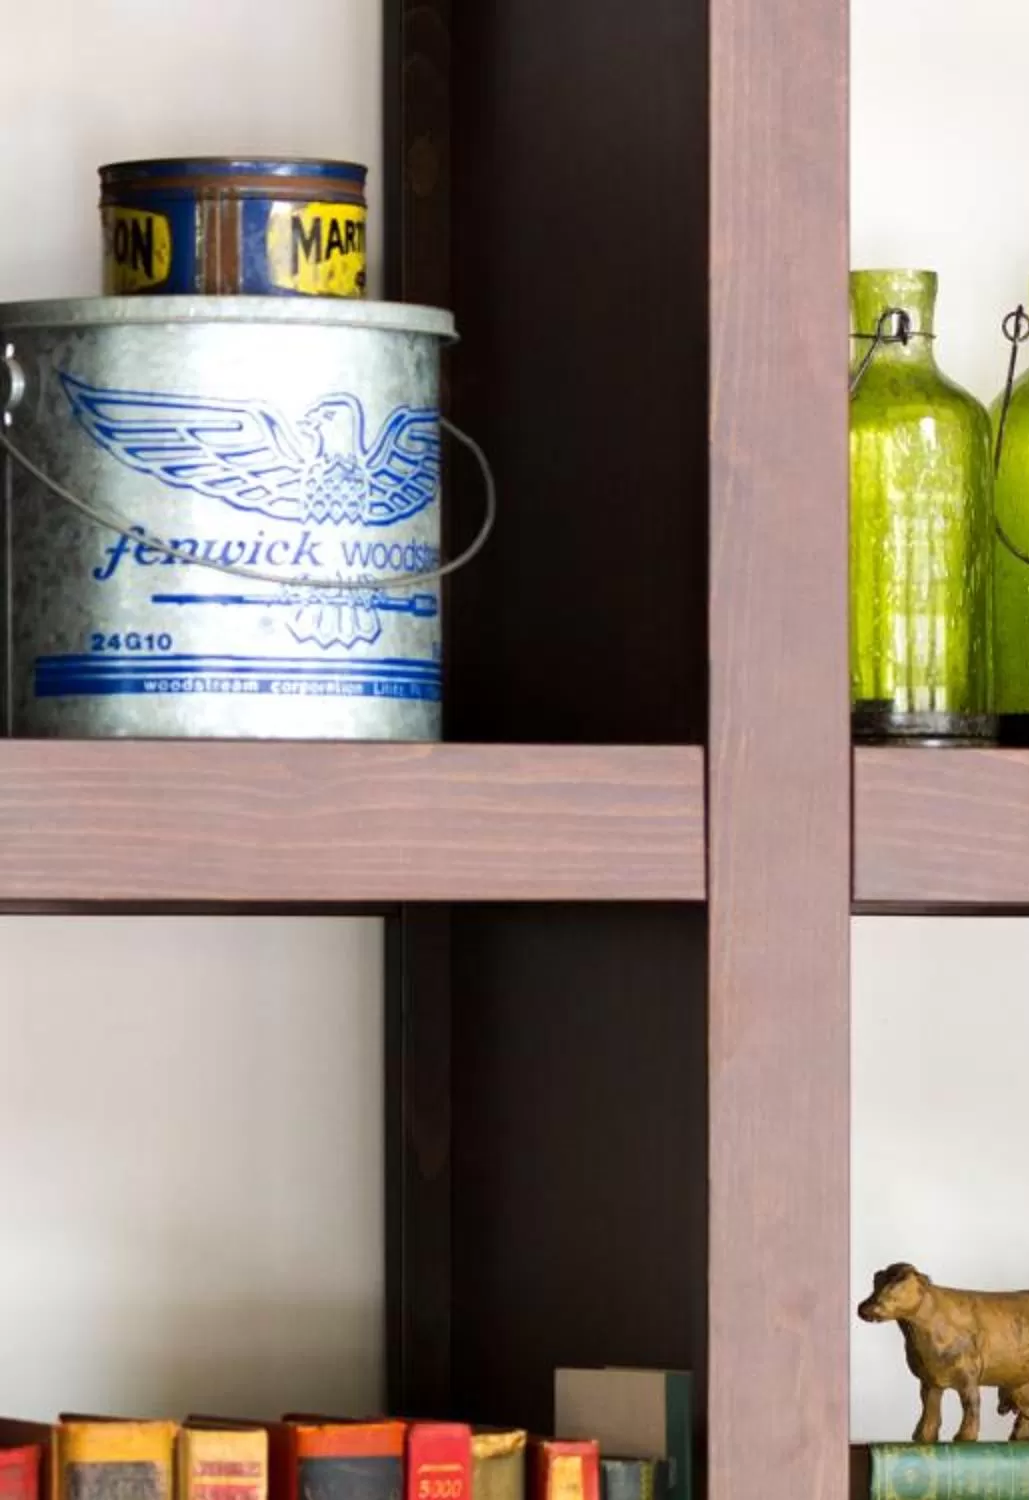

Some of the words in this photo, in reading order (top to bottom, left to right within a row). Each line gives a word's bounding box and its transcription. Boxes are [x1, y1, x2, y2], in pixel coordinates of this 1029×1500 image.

[106, 214, 153, 280] ON
[93, 525, 321, 581] fenwick
[91, 632, 172, 650] 24G10
[144, 678, 258, 692] woodstream
